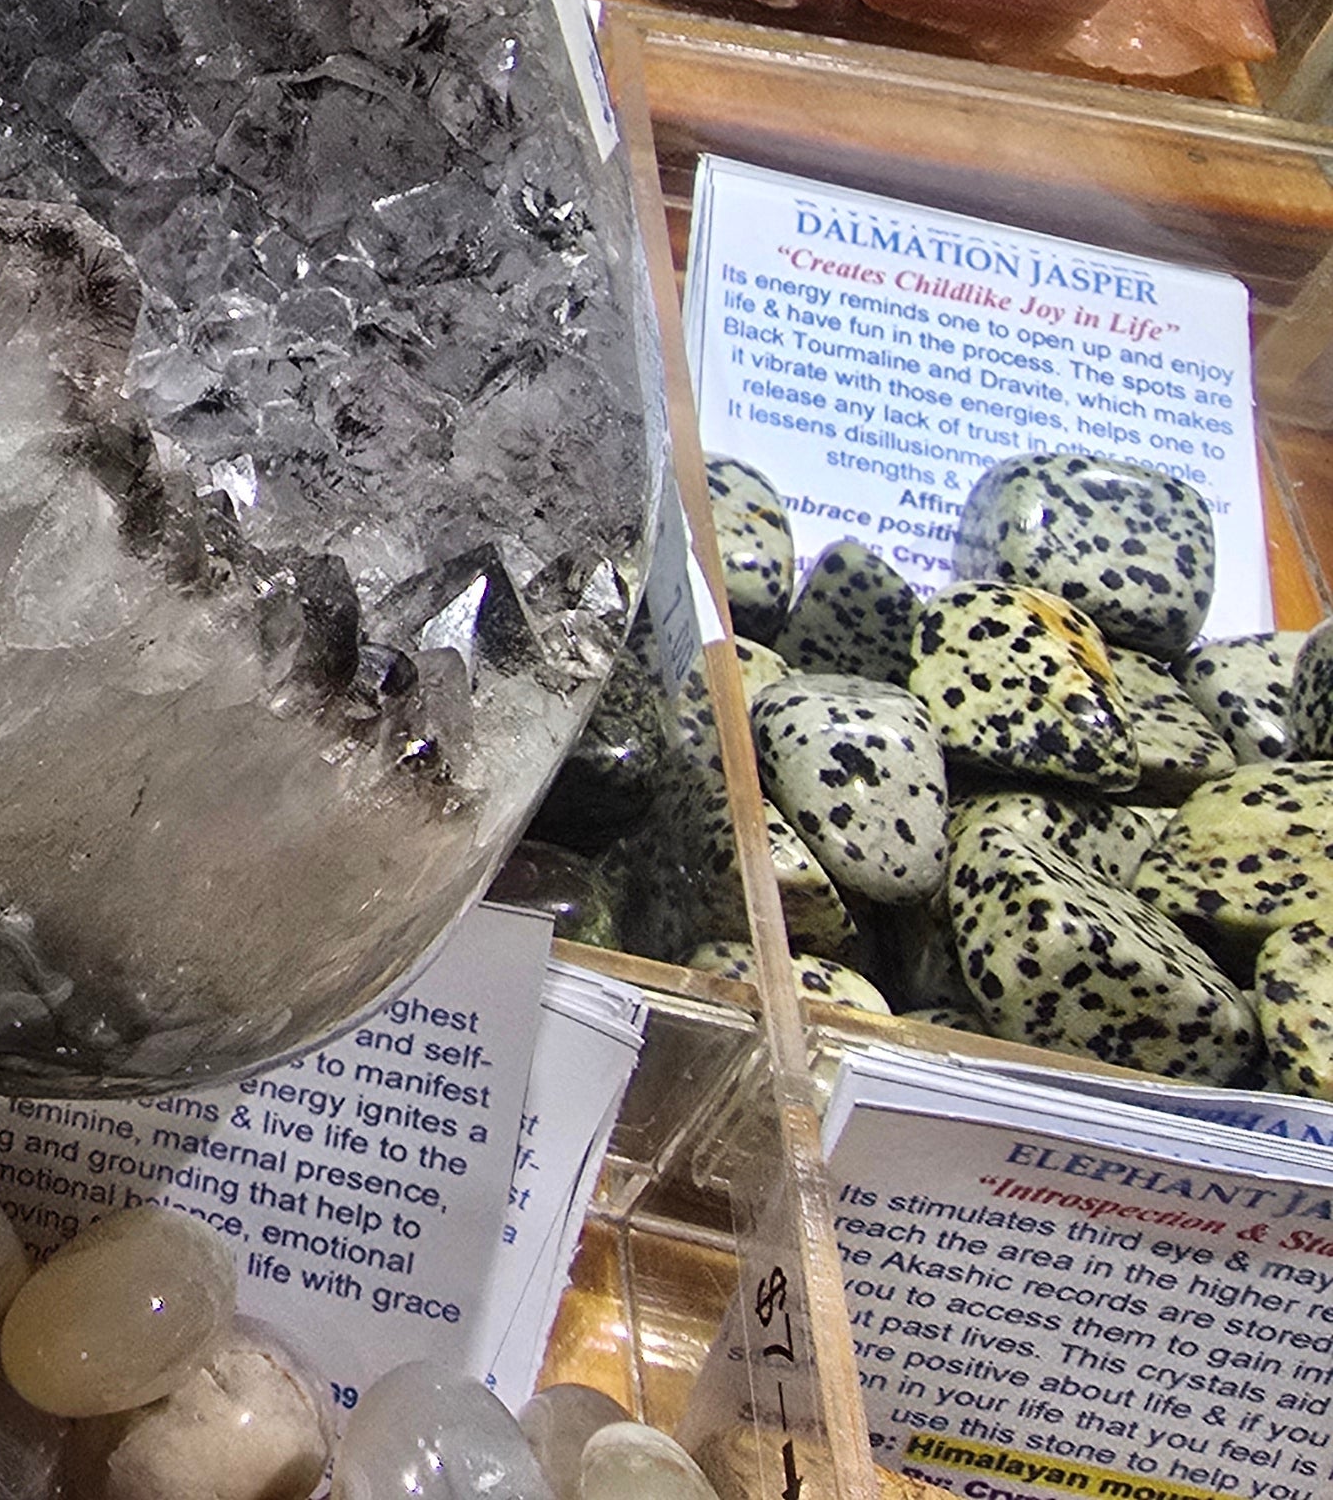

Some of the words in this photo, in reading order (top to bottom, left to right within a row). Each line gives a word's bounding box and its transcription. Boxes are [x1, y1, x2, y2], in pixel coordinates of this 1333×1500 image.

[777, 246, 886, 285] “Creates
[894, 270, 1012, 311] Childlike
[1019, 296, 1066, 326] Joy
[1074, 305, 1100, 329] in
[1109, 312, 1180, 343] Life”
[797, 211, 1019, 278] DALMATION
[1030, 259, 1157, 305] JASPER
[722, 263, 748, 286] Its
[754, 274, 831, 307] energy
[839, 292, 930, 324] reminds
[937, 312, 980, 333] one
[987, 319, 1010, 339] to
[1016, 328, 1075, 352] open
[1082, 341, 1112, 362] up
[1119, 348, 1163, 370] and
[1170, 358, 1233, 387] enjoy
[723, 316, 784, 347] Black
[792, 330, 921, 375] Tourmaline
[928, 363, 972, 385] and
[980, 368, 1069, 406] Dravite,
[1077, 392, 1147, 419] which
[1154, 408, 1233, 435] makes
[732, 347, 744, 365] it
[751, 353, 828, 382] vibrate
[834, 370, 882, 393] with
[888, 378, 953, 408] those
[960, 396, 1068, 433] energies,
[1077, 415, 1141, 445] helps
[1149, 433, 1194, 455] one
[1201, 441, 1225, 460] to
[317, 1051, 345, 1078] to
[354, 1064, 490, 1109] manifest
[355, 1028, 415, 1056] and
[424, 1042, 492, 1070] self-
[230, 1104, 251, 1130] &
[263, 1110, 314, 1143] live
[324, 1123, 369, 1155] life
[379, 1136, 408, 1163] to
[419, 1145, 467, 1176] the
[241, 1078, 347, 1120] energy
[356, 1100, 458, 1138] ignites
[468, 1124, 488, 1144] a
[152, 1128, 287, 1174] maternal
[295, 1160, 447, 1214] presence,
[979, 1176, 1227, 1235] “Introspection
[1235, 1222, 1270, 1244] &
[1005, 1141, 1277, 1219] ELEPHANT
[839, 1184, 878, 1207] Its
[887, 1195, 1057, 1237] stimulates
[1067, 1221, 1144, 1252] third
[1150, 1240, 1215, 1265] eye
[1224, 1250, 1250, 1273] &
[1259, 1261, 1333, 1295] may
[247, 1252, 291, 1284] life
[301, 1269, 362, 1301] with
[371, 1287, 461, 1324] grace
[879, 1250, 1013, 1291] Akashic
[1022, 1279, 1149, 1317] records
[1157, 1305, 1216, 1329] are
[1223, 1318, 1333, 1354] stored
[880, 1316, 954, 1343] past
[961, 1326, 1040, 1359] lives.
[1061, 1343, 1127, 1375] This
[1136, 1363, 1266, 1404] crystals
[1275, 1391, 1332, 1416] aid
